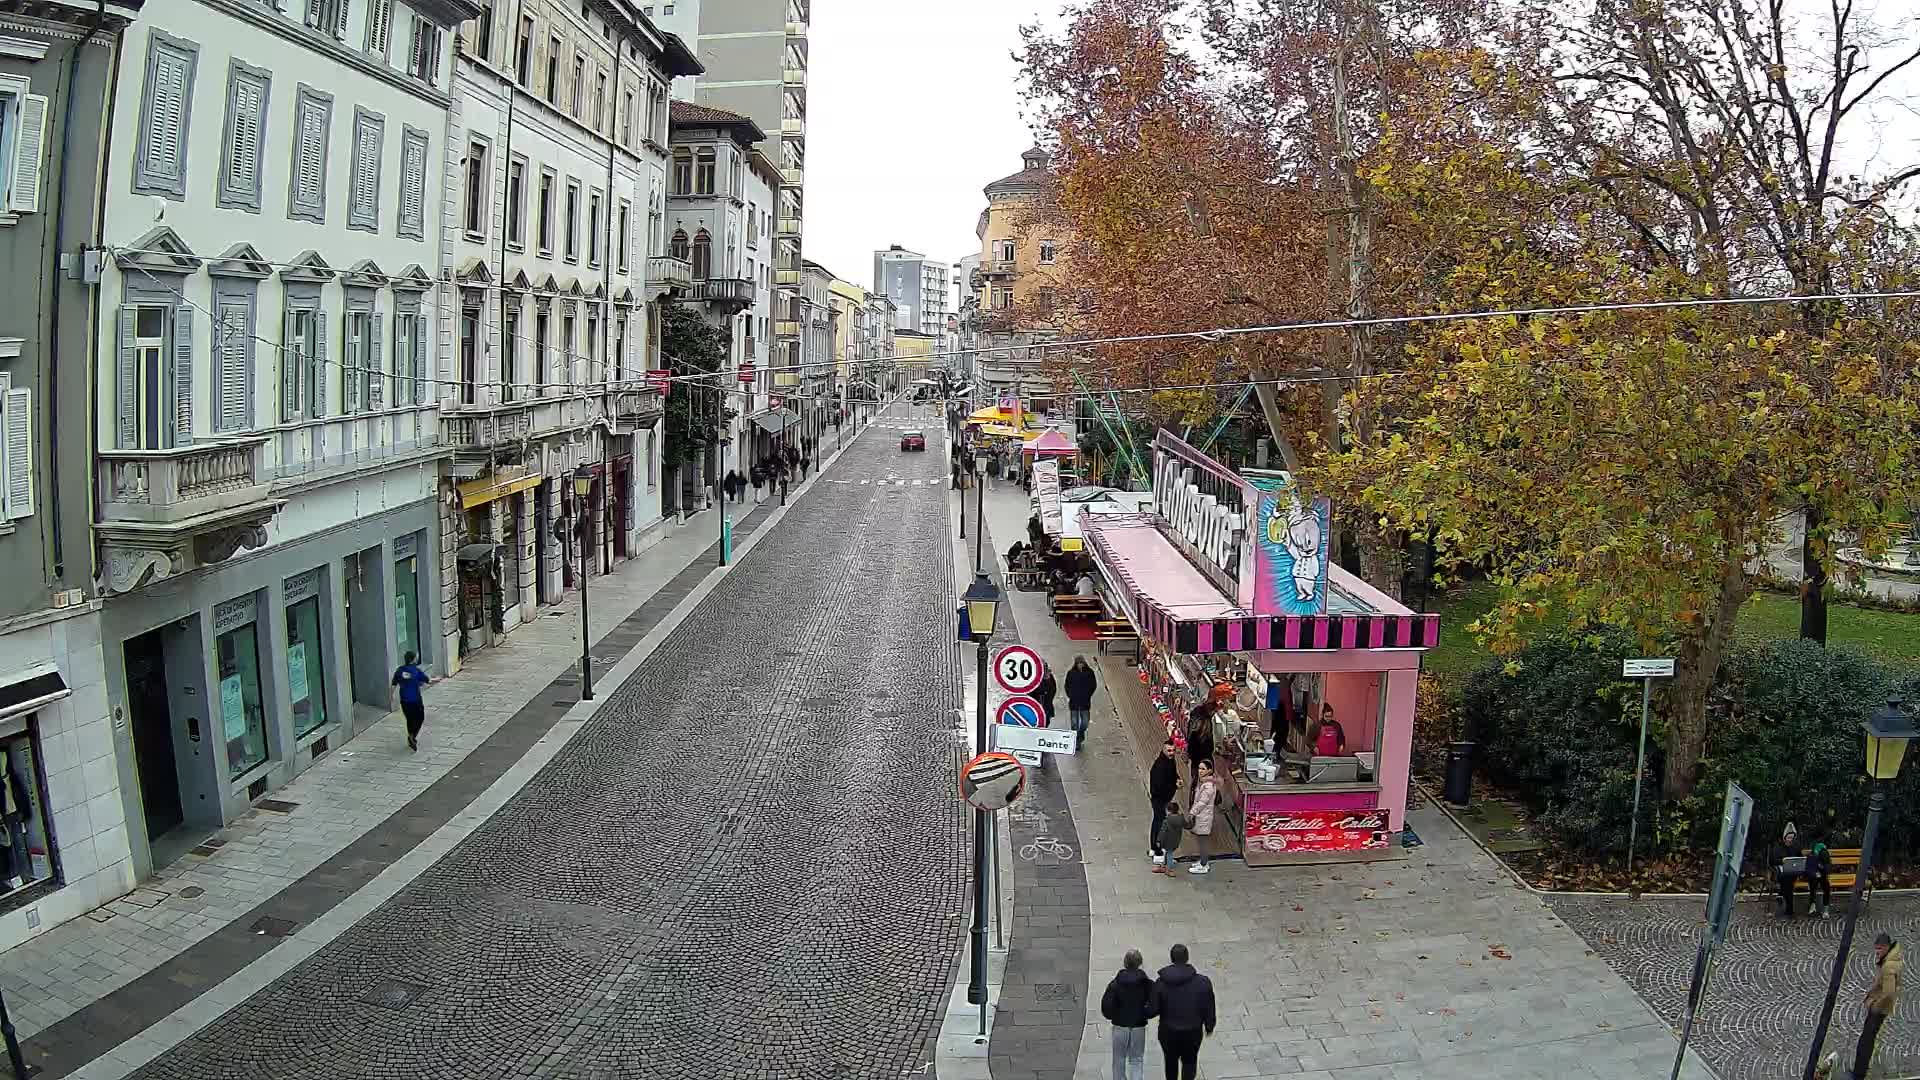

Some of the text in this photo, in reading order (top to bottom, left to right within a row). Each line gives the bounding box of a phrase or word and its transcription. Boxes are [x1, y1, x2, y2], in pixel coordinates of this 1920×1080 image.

[1005, 659, 1033, 680] 30
[1038, 738, 1069, 750] Dante
[1260, 816, 1327, 831] Frittelle
